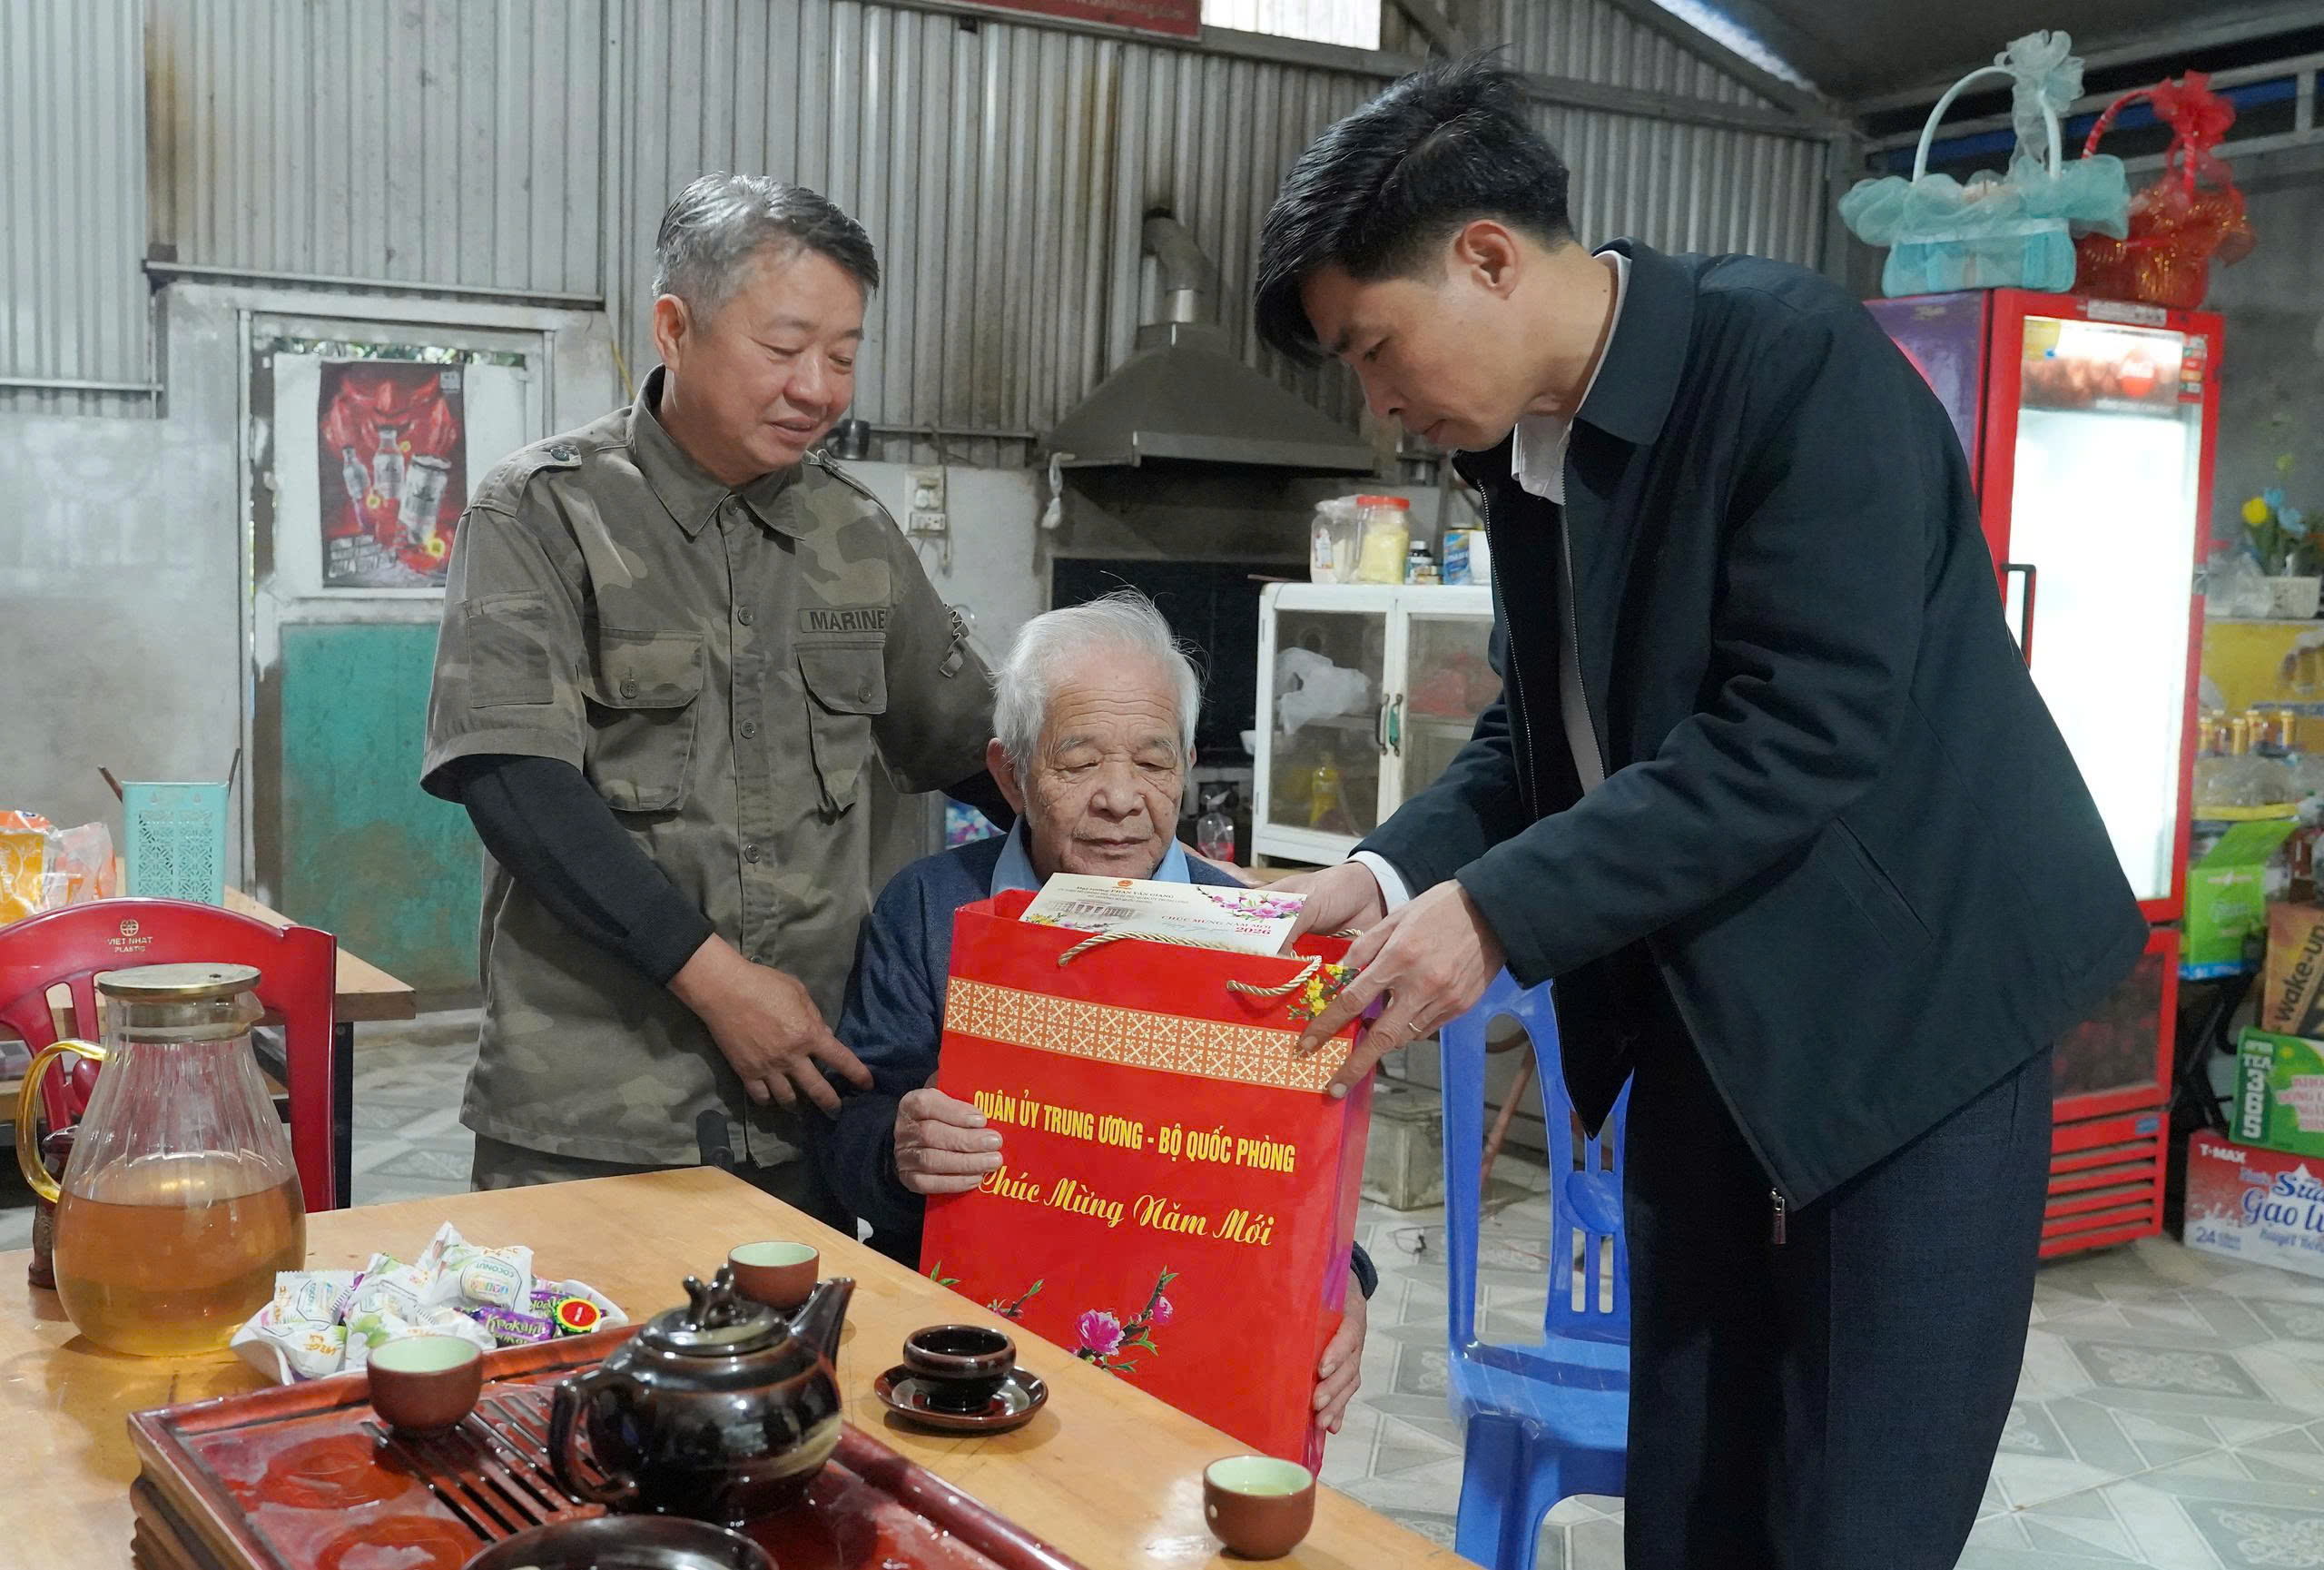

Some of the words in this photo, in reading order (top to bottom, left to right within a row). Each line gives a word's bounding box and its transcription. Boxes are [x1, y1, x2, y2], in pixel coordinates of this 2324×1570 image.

[810, 609, 885, 630] MARINE
[1235, 926, 1271, 935] 2026
[973, 1090, 1016, 1123] QUÂN
[1019, 1090, 1040, 1129] ỦY
[1044, 1104, 1095, 1141] TRUNG
[1098, 1115, 1144, 1150] ƯƠNG
[1157, 1122, 1183, 1162] BỘ
[1186, 1125, 1232, 1163] QUỐC
[1236, 1135, 1296, 1173] PHÒNG
[978, 1165, 1040, 1203] Chúc
[1043, 1177, 1124, 1229] Mừng
[1133, 1194, 1208, 1236] Năm
[1212, 1208, 1275, 1247] Mới
